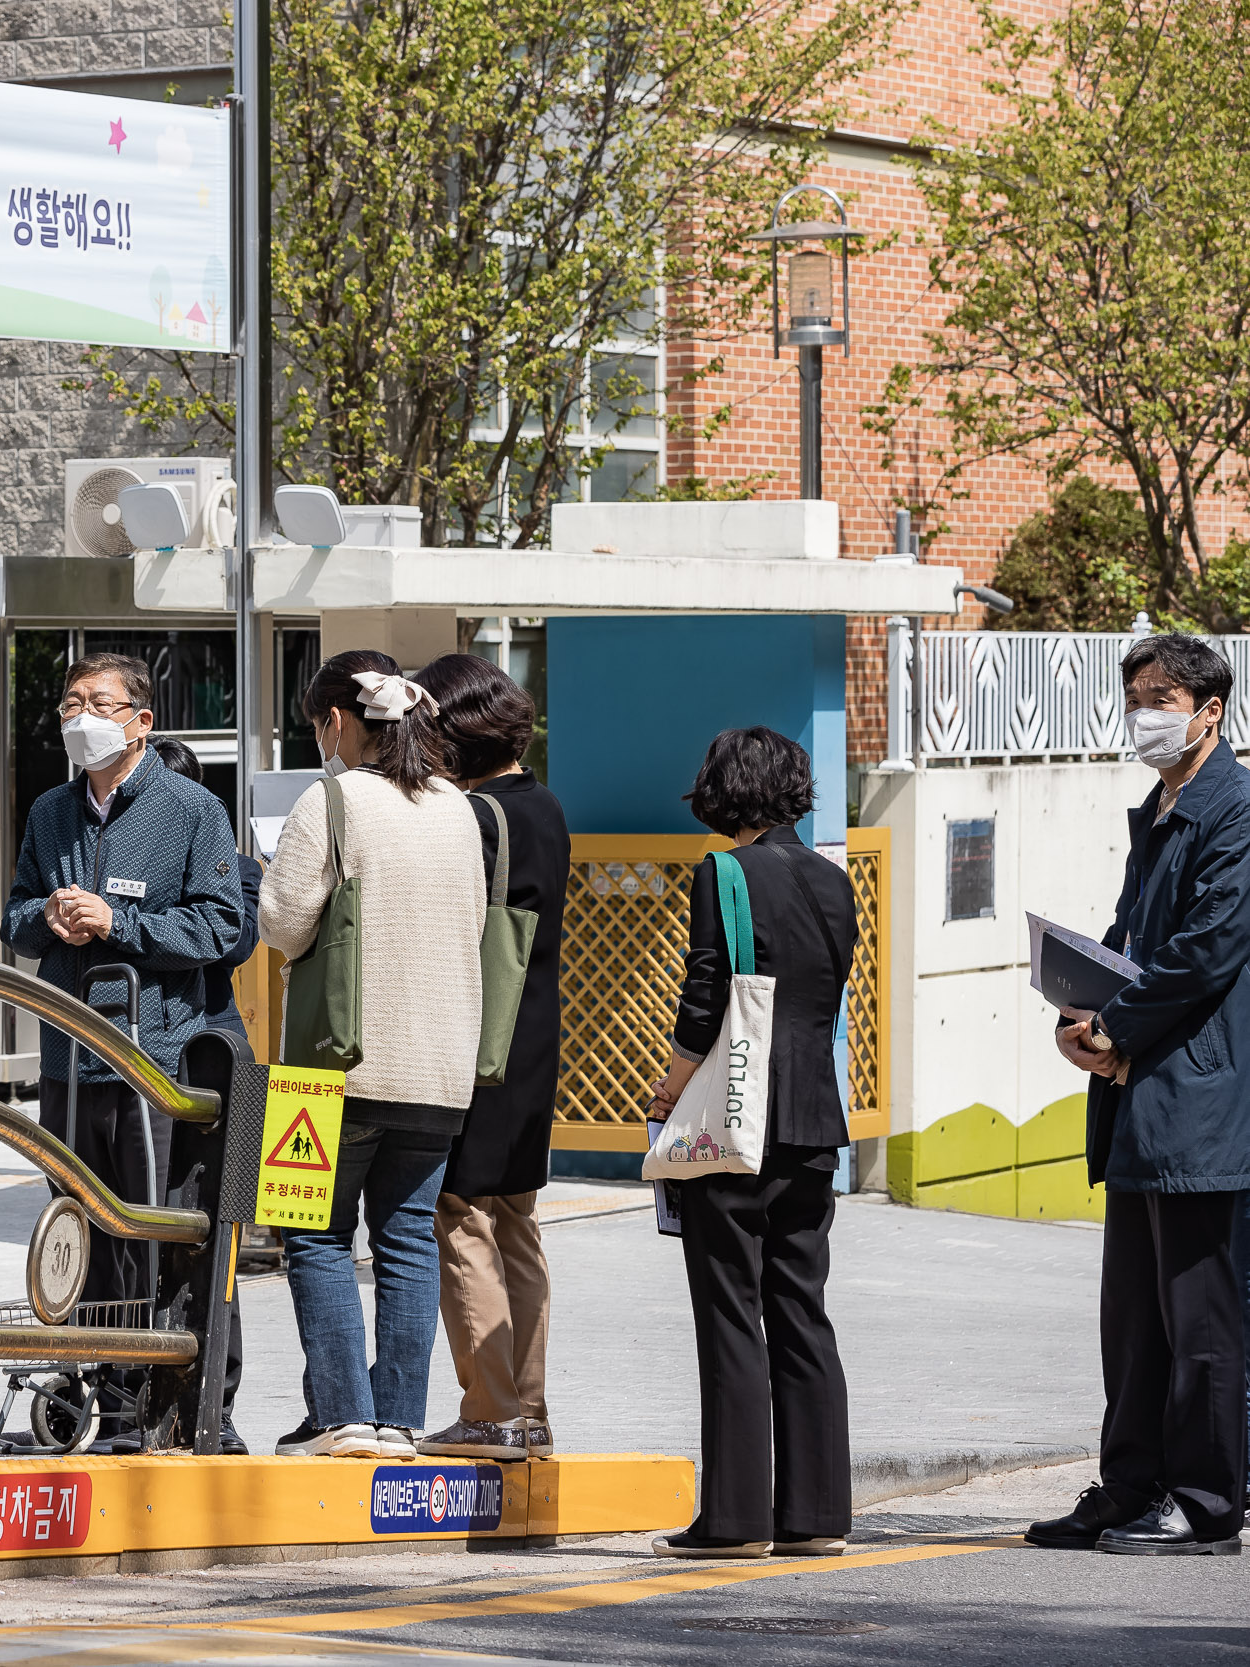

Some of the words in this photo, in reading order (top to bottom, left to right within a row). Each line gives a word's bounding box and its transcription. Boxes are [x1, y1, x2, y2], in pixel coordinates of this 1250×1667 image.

[8, 187, 132, 251] 생활해요!!
[159, 467, 196, 476] SAMSUNG
[269, 1079, 345, 1099] 어린이보호구역
[724, 1038, 750, 1129] 50PLUS
[264, 1182, 328, 1201] 주정차금지
[51, 1241, 71, 1277] 30
[373, 1478, 430, 1518] 어린이보호구역
[433, 1489, 445, 1508] 30
[447, 1479, 478, 1517] SCHOOL
[479, 1479, 501, 1516] ZONE
